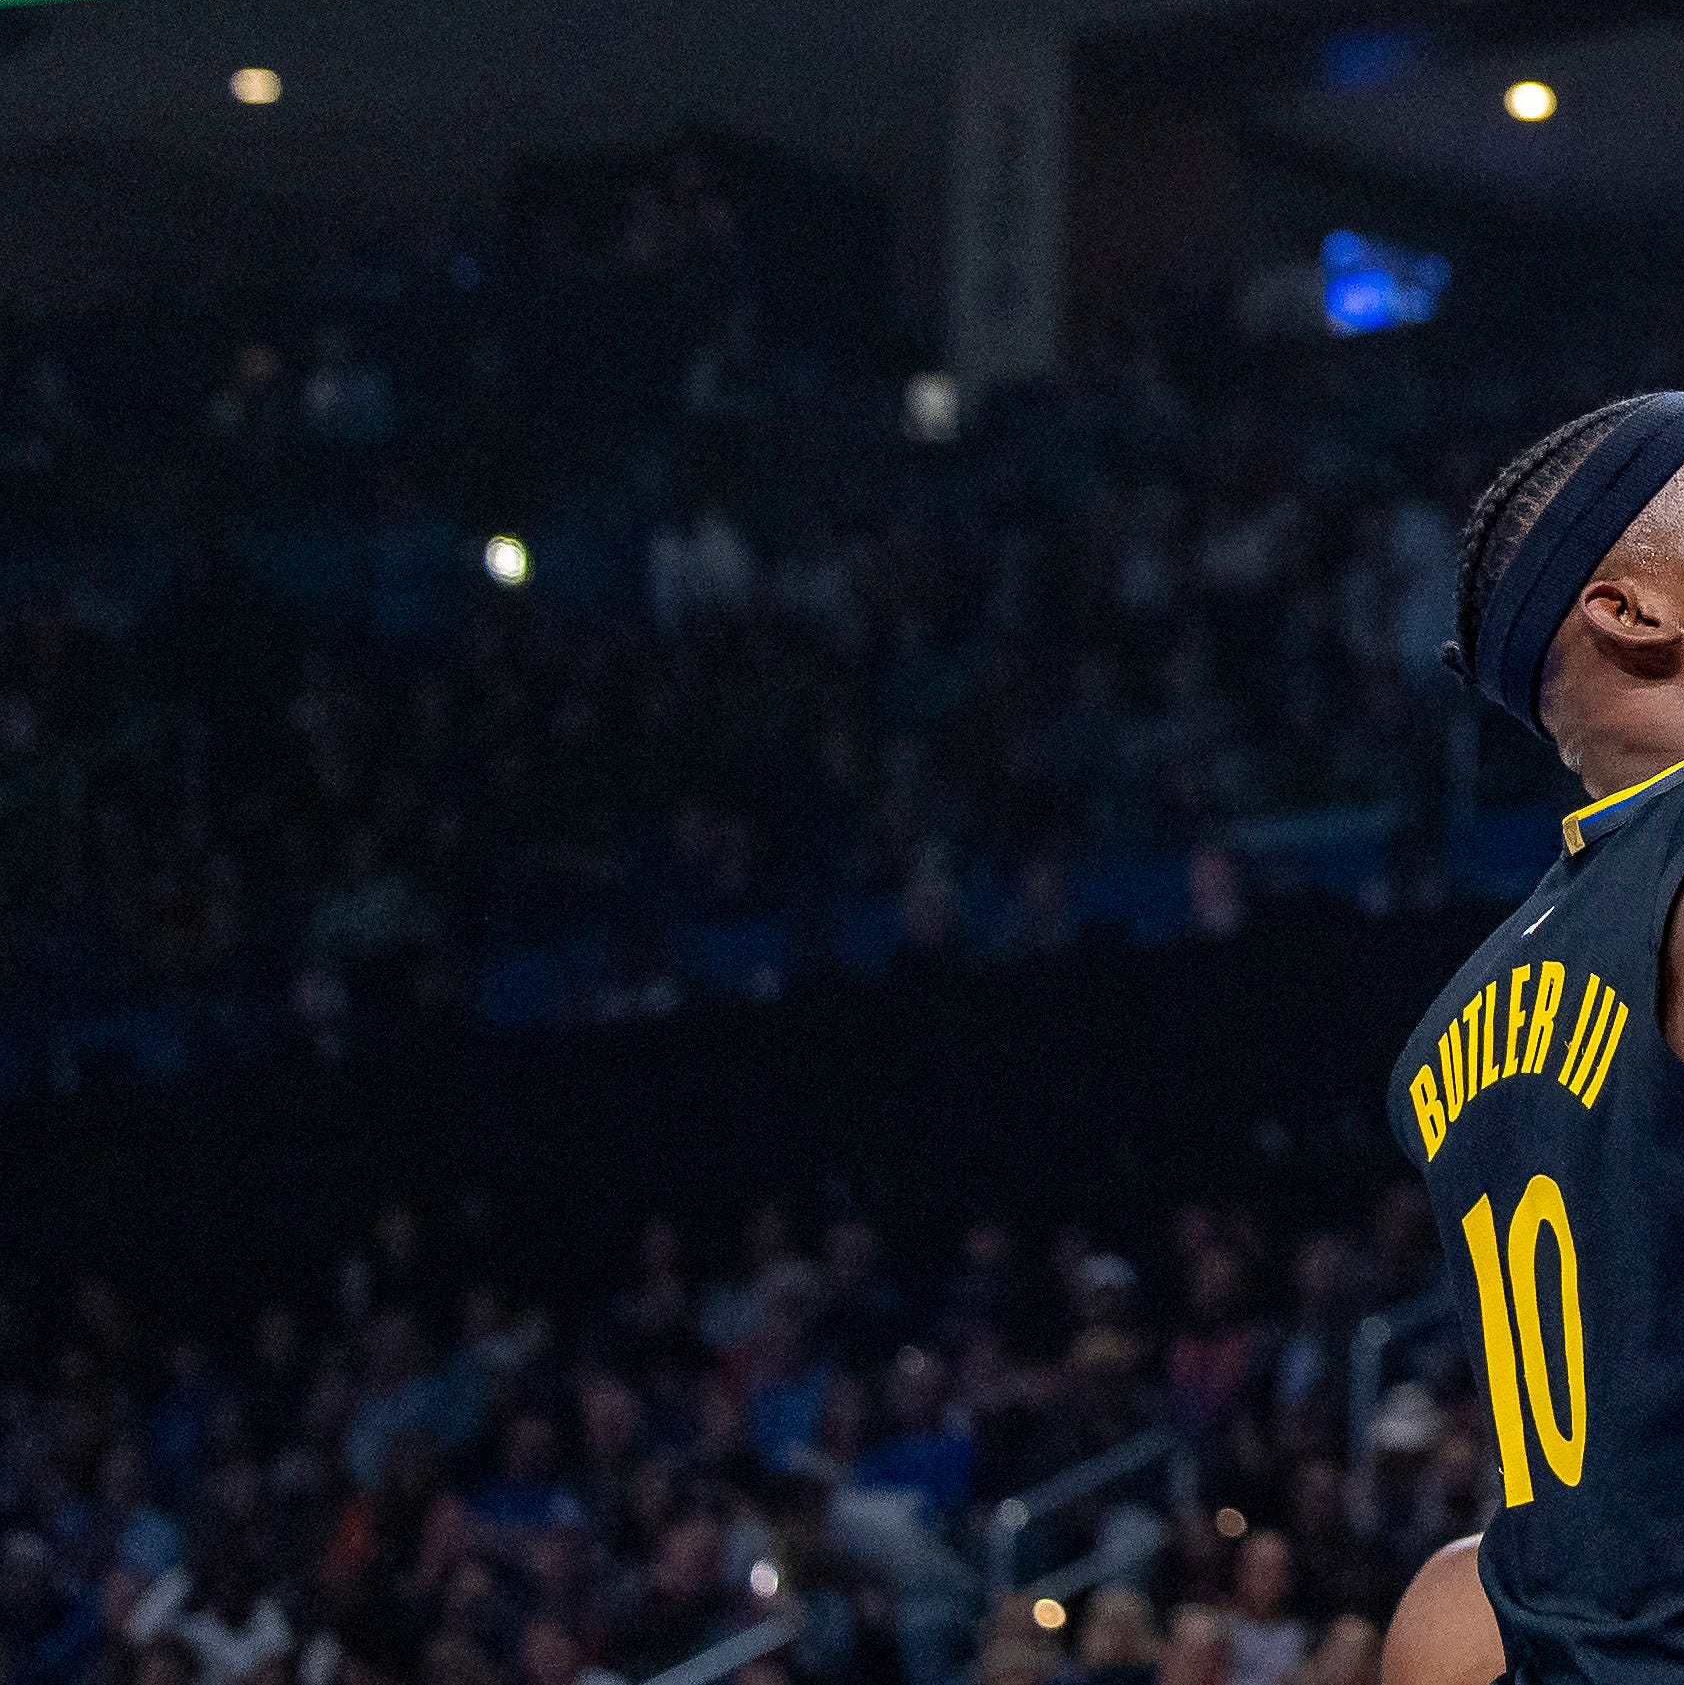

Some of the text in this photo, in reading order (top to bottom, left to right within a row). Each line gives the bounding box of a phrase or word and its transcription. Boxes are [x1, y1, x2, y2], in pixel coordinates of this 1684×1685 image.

[1409, 960, 1629, 1163] BUTLER III
[1461, 1173, 1588, 1509] 10
